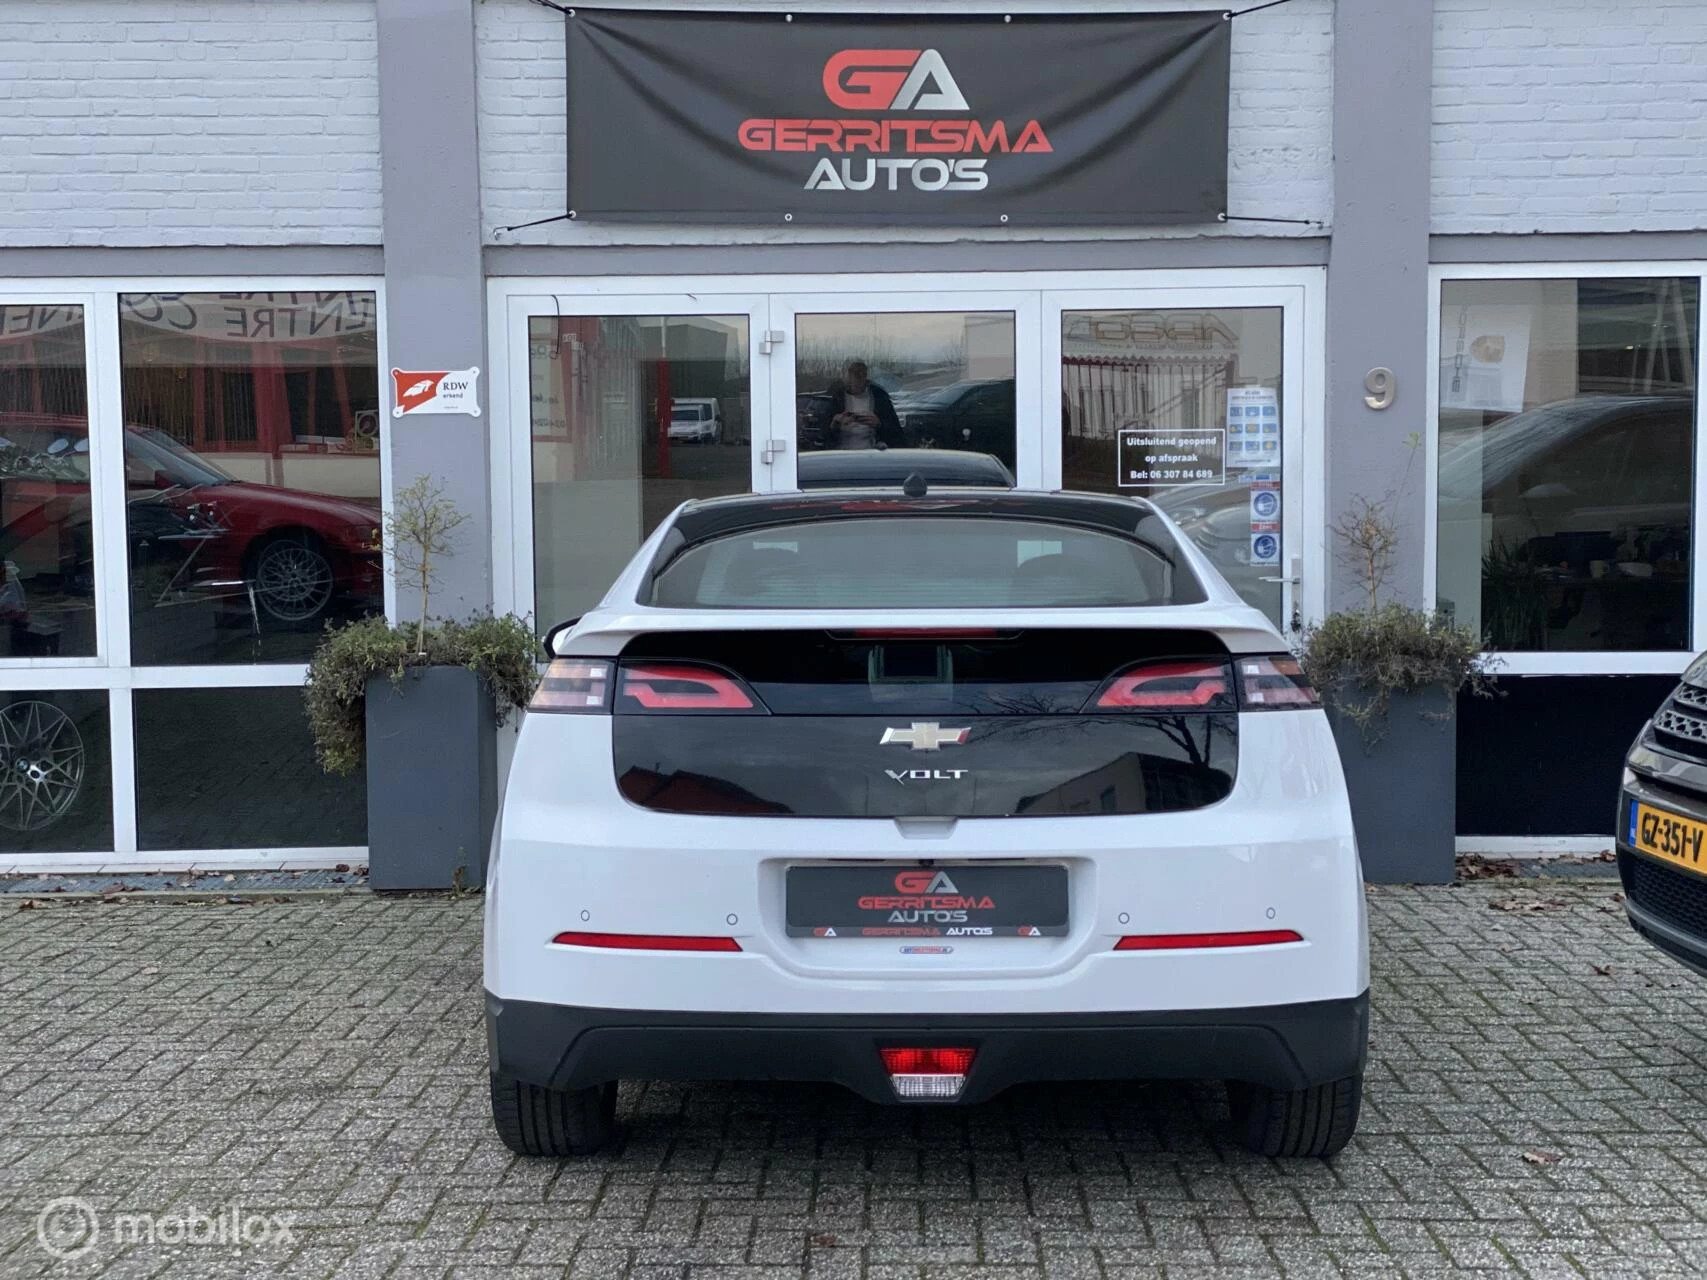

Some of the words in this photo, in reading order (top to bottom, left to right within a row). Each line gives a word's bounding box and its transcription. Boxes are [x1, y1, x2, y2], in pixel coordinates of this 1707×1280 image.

[822, 48, 970, 111] GA
[738, 119, 1054, 153] GERRITSMA
[803, 157, 989, 191] AUTO'S
[443, 382, 468, 390] RDW
[1364, 366, 1396, 411] 9
[1127, 437, 1176, 446] Uitsluitend
[1178, 436, 1217, 447] geopend
[1145, 455, 1156, 463] op
[1158, 454, 1198, 463] afspraak
[1130, 470, 1148, 479] Bel:
[1150, 470, 1161, 479] 06
[1163, 470, 1180, 479] 307
[1182, 470, 1194, 479] 84
[1196, 470, 1213, 479] 689
[884, 769, 969, 786] VOLT
[894, 871, 959, 894] GA
[857, 896, 996, 910] GERRITSMA
[887, 910, 969, 923] AUTO'S
[813, 927, 837, 937] GA
[862, 927, 941, 937] GERRITSMA
[946, 927, 993, 936] AUTO'S
[1018, 926, 1041, 937] GA
